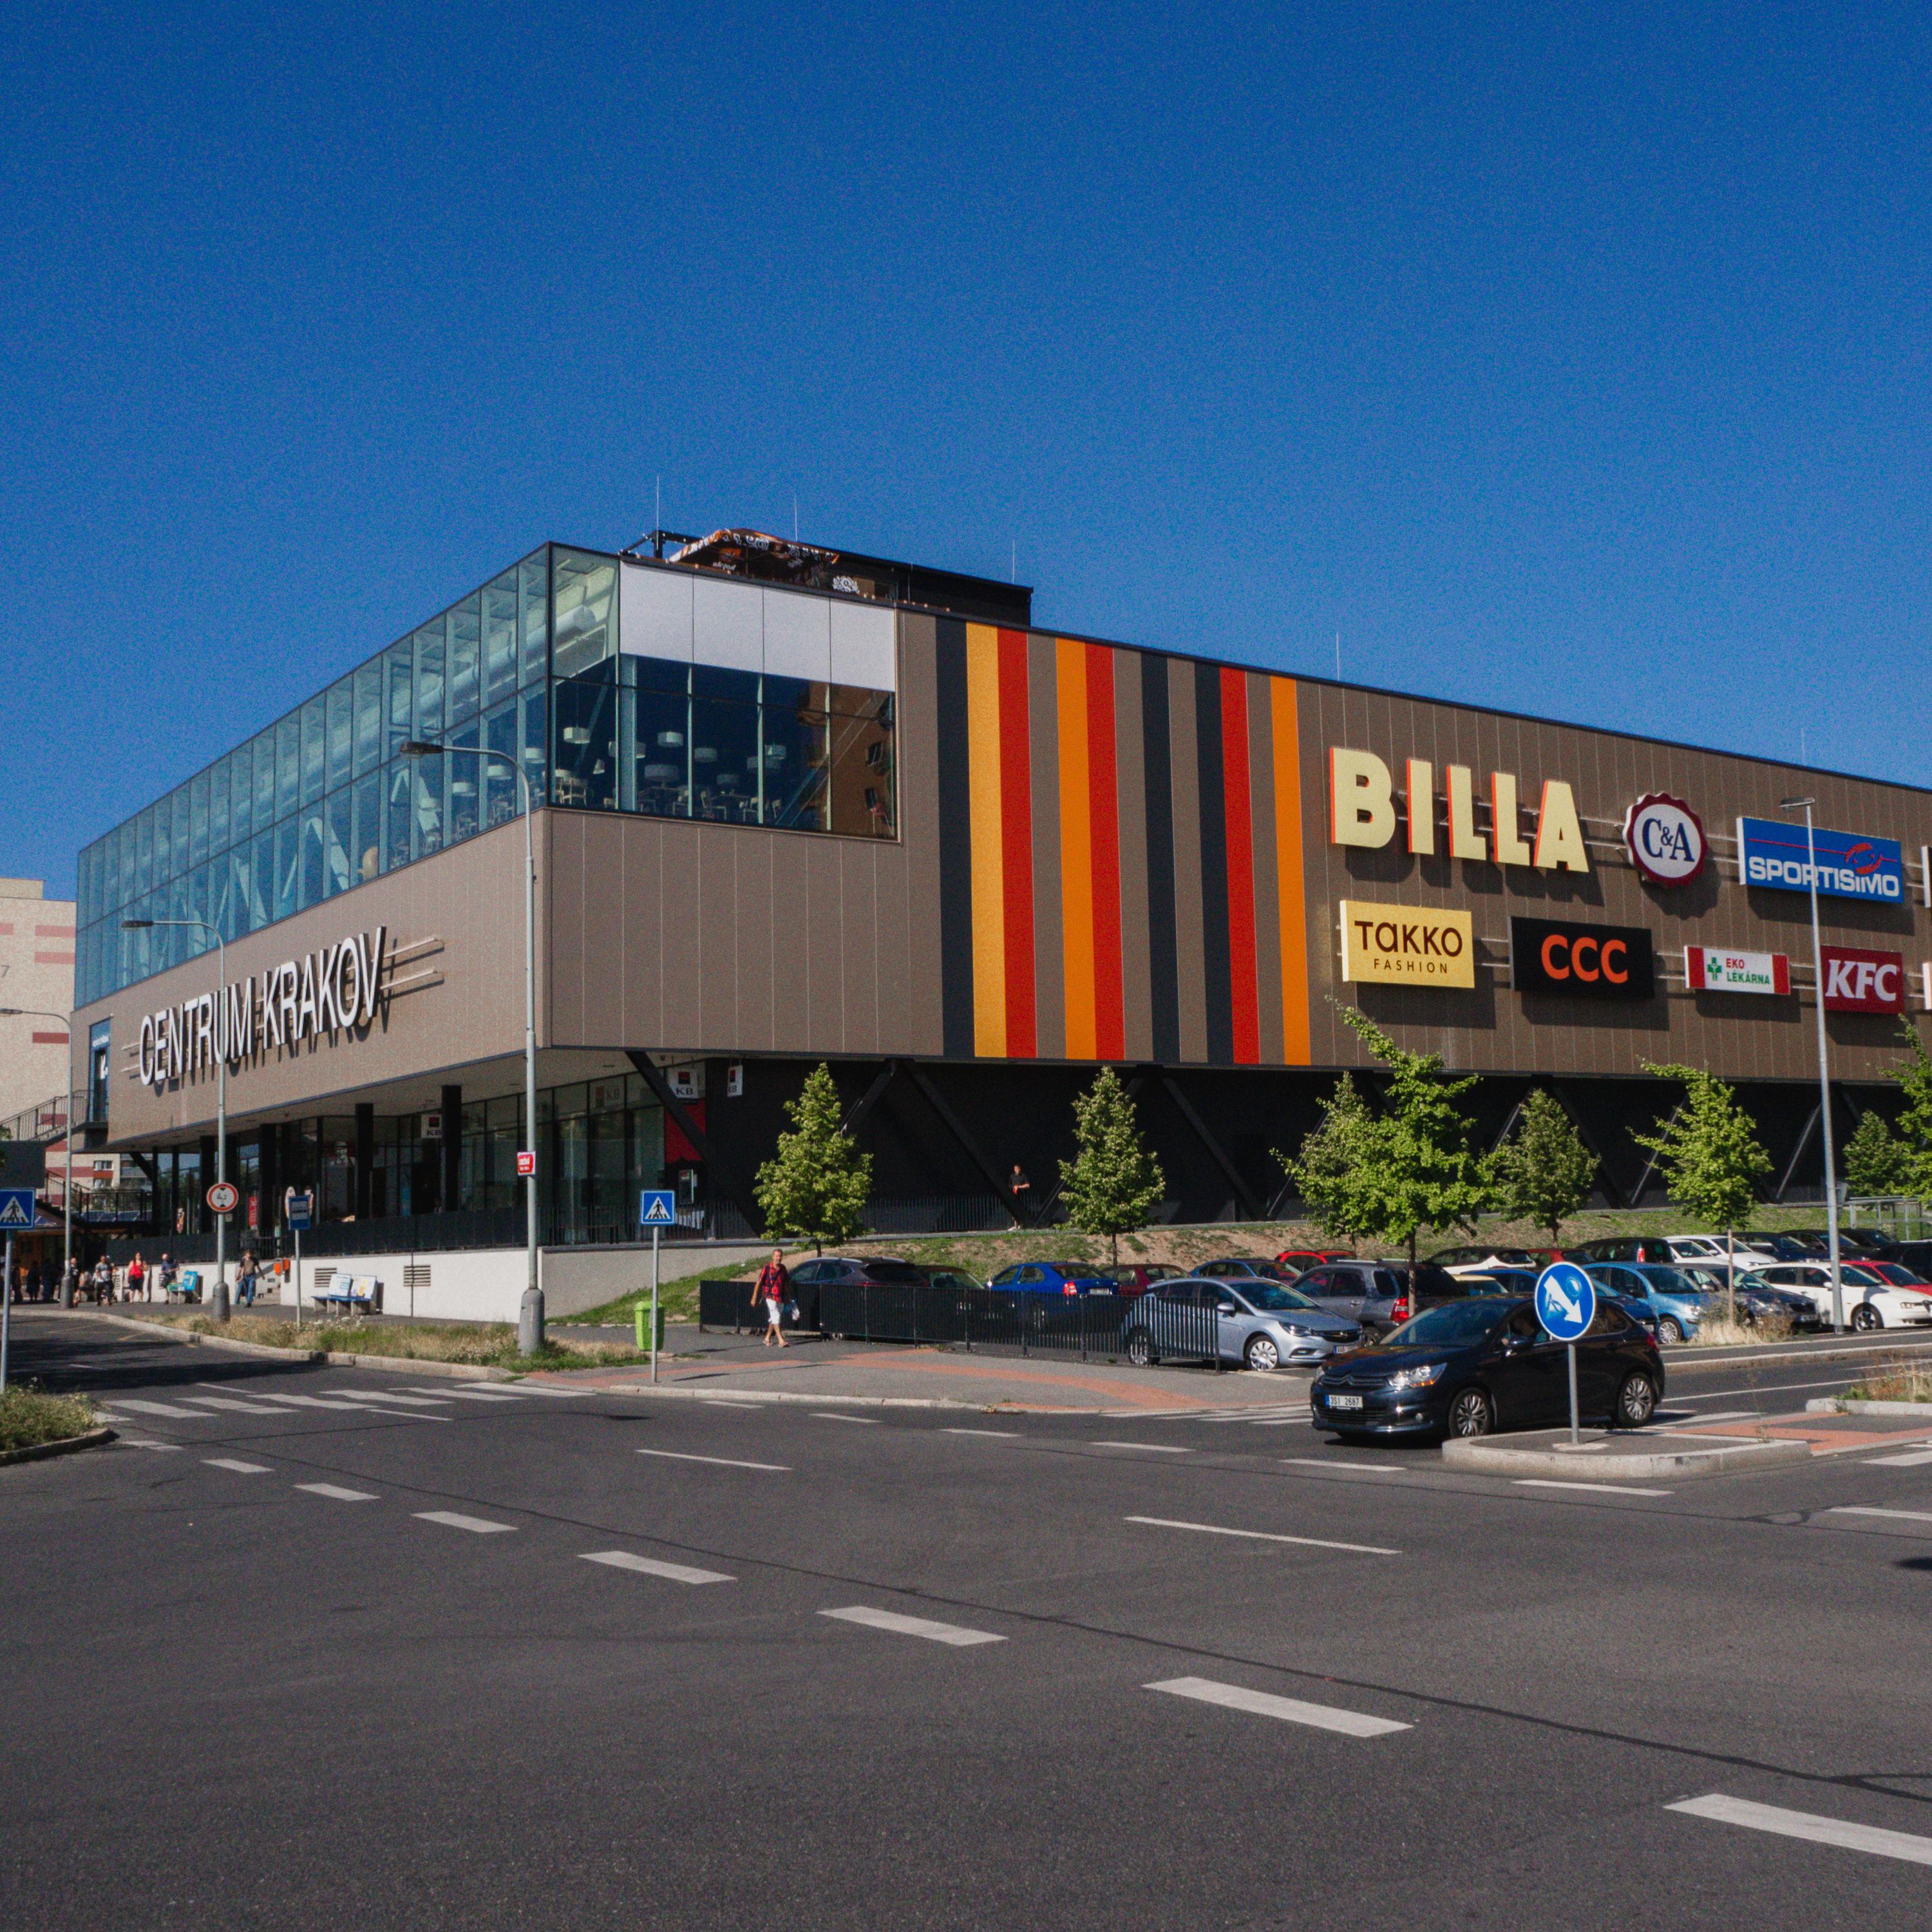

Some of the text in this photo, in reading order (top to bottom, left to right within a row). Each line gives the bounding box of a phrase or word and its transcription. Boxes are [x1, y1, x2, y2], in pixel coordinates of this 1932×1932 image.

[1331, 747, 1589, 873] BILLA
[1642, 818, 1695, 862] C&A
[1374, 958, 1448, 974] FASHION
[1541, 934, 1628, 984] CCC
[1726, 958, 1745, 969] EKO
[1726, 970, 1770, 985] LÉKÁRNA
[1825, 959, 1898, 1001] KFC
[140, 926, 381, 1086] CENTRUM KRAKOV
